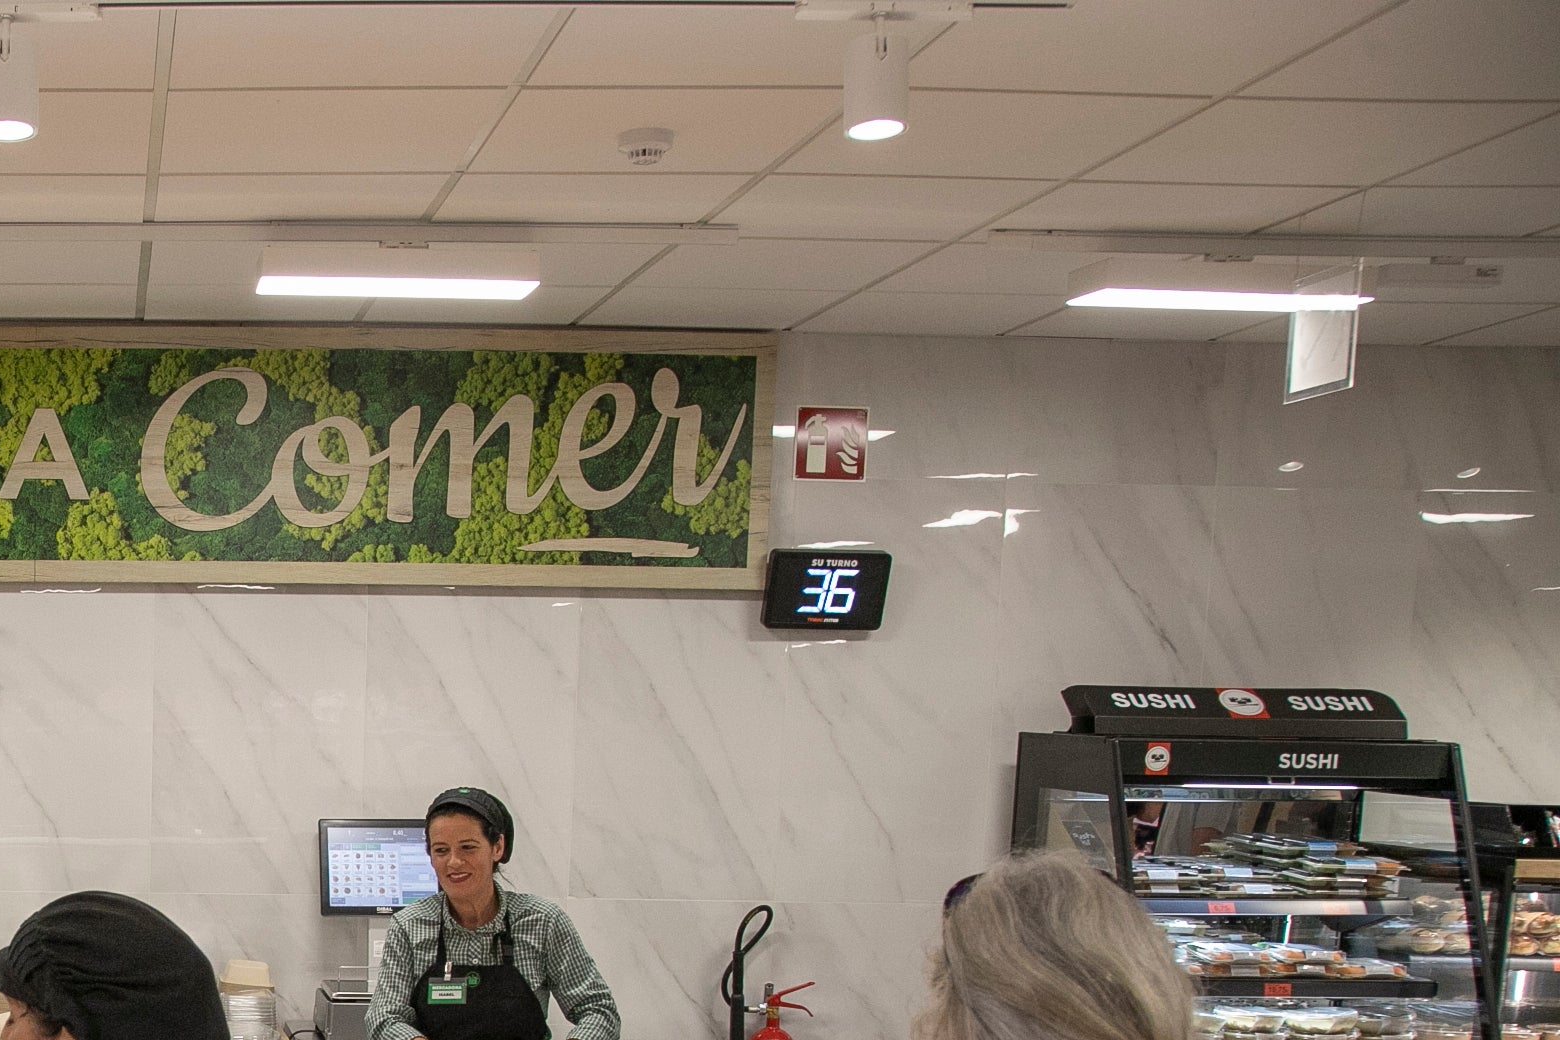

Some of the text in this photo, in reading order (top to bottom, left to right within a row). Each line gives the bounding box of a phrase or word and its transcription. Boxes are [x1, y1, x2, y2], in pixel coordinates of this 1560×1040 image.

[140, 367, 747, 532] Comer
[811, 559, 858, 567] SU TURNO
[794, 568, 860, 614] 36
[1110, 692, 1196, 709] SUSHI
[1287, 695, 1374, 712] SUSHI
[1278, 753, 1339, 769] SUSHI
